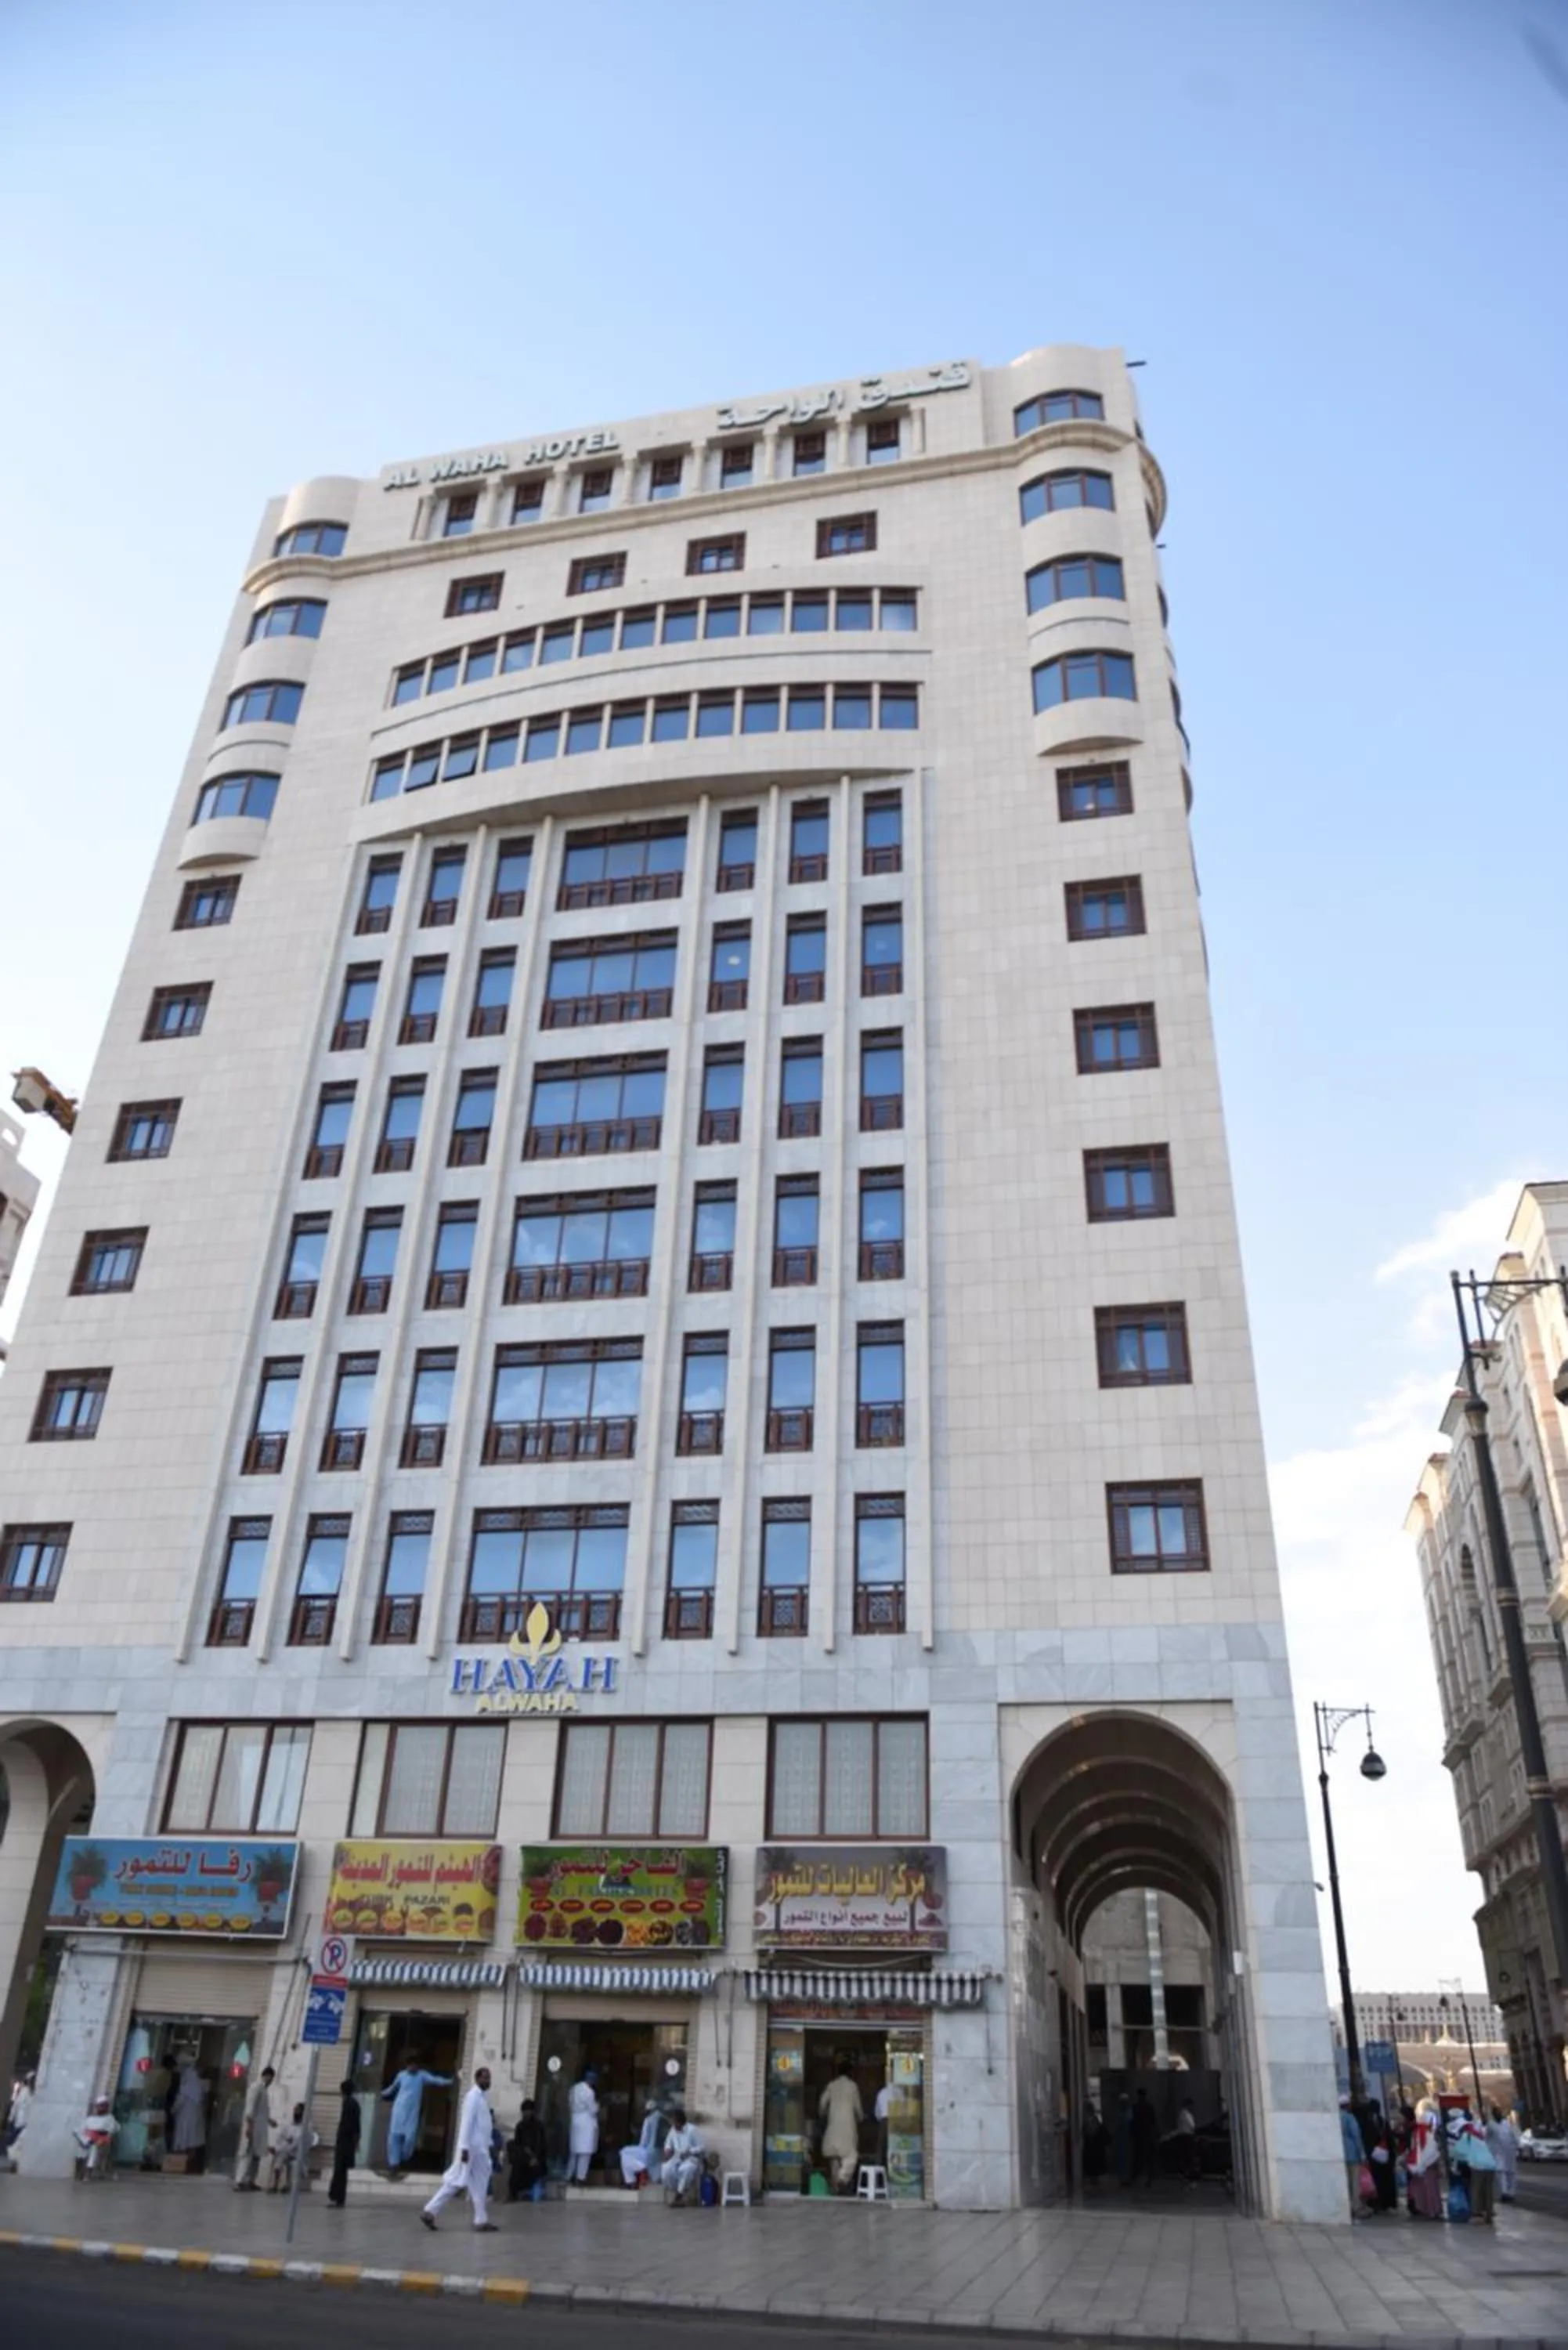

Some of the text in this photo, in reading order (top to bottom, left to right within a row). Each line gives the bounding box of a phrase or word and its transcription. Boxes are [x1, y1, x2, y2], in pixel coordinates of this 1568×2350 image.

[717, 389, 845, 429] الواحة
[384, 431, 620, 491] AL WAHA HOTEL
[450, 1657, 619, 1694] HAYAH
[475, 1692, 580, 1715] ALWAHA
[114, 1849, 251, 1882] رفا للتمور
[768, 1864, 815, 1904] للتمور
[886, 1863, 926, 1905] مركز
[783, 1909, 818, 1925] التمور
[850, 1911, 881, 1926] جميع
